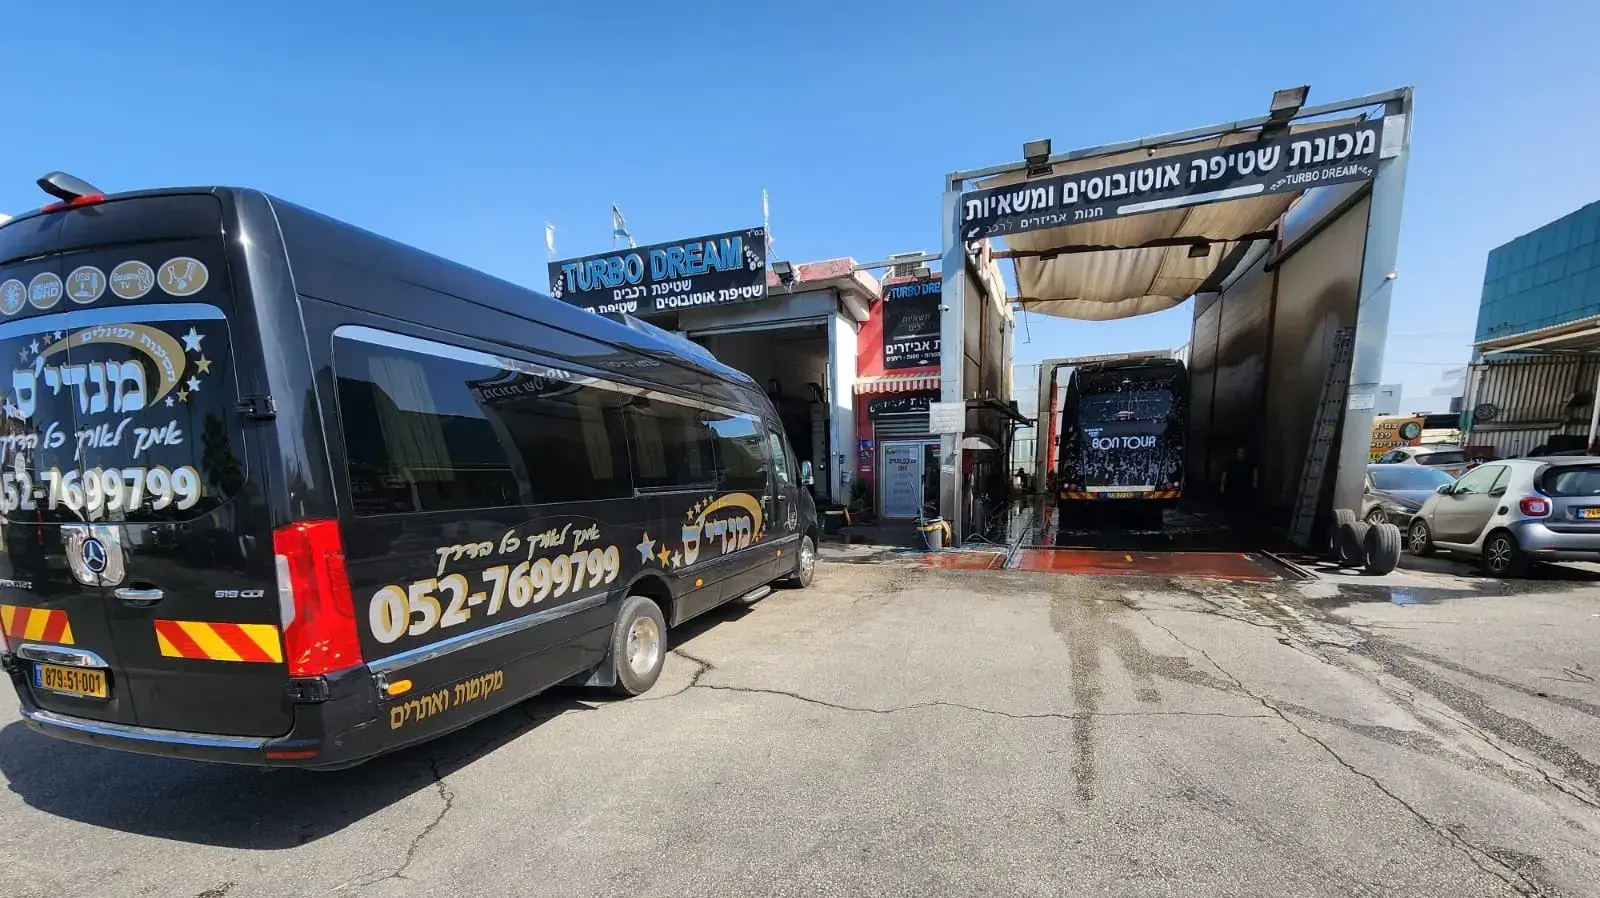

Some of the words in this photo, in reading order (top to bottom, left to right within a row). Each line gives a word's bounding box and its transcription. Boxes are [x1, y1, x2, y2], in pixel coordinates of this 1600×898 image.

[1289, 129, 1376, 167] מכונת
[1189, 145, 1281, 183] שטיפה
[1286, 168, 1320, 185] TURBO
[1321, 164, 1358, 180] DREAM
[1063, 162, 1180, 206] אוטובוסים
[966, 185, 1054, 222] ומשאיות
[1020, 213, 1067, 229] אביזרים
[1073, 206, 1104, 221] חנות
[746, 228, 764, 238] בס"ד
[985, 219, 1014, 234] לרכב
[561, 252, 645, 294] TURBO
[650, 235, 745, 282] DREAM
[75, 272, 91, 282] USB
[120, 282, 131, 290] TV
[613, 285, 647, 301] רכבים
[652, 279, 692, 296] שטיפת
[719, 284, 764, 302] שטיפת
[891, 284, 921, 299] TURBO
[656, 292, 716, 310] אוטובוסים
[886, 341, 930, 355] אביזרים
[1092, 437, 1120, 450] BON
[1121, 435, 1157, 450] TOUR
[368, 544, 621, 645] 052-7699799
[453, 670, 504, 706] מקומות
[390, 688, 449, 730] ואתרים
